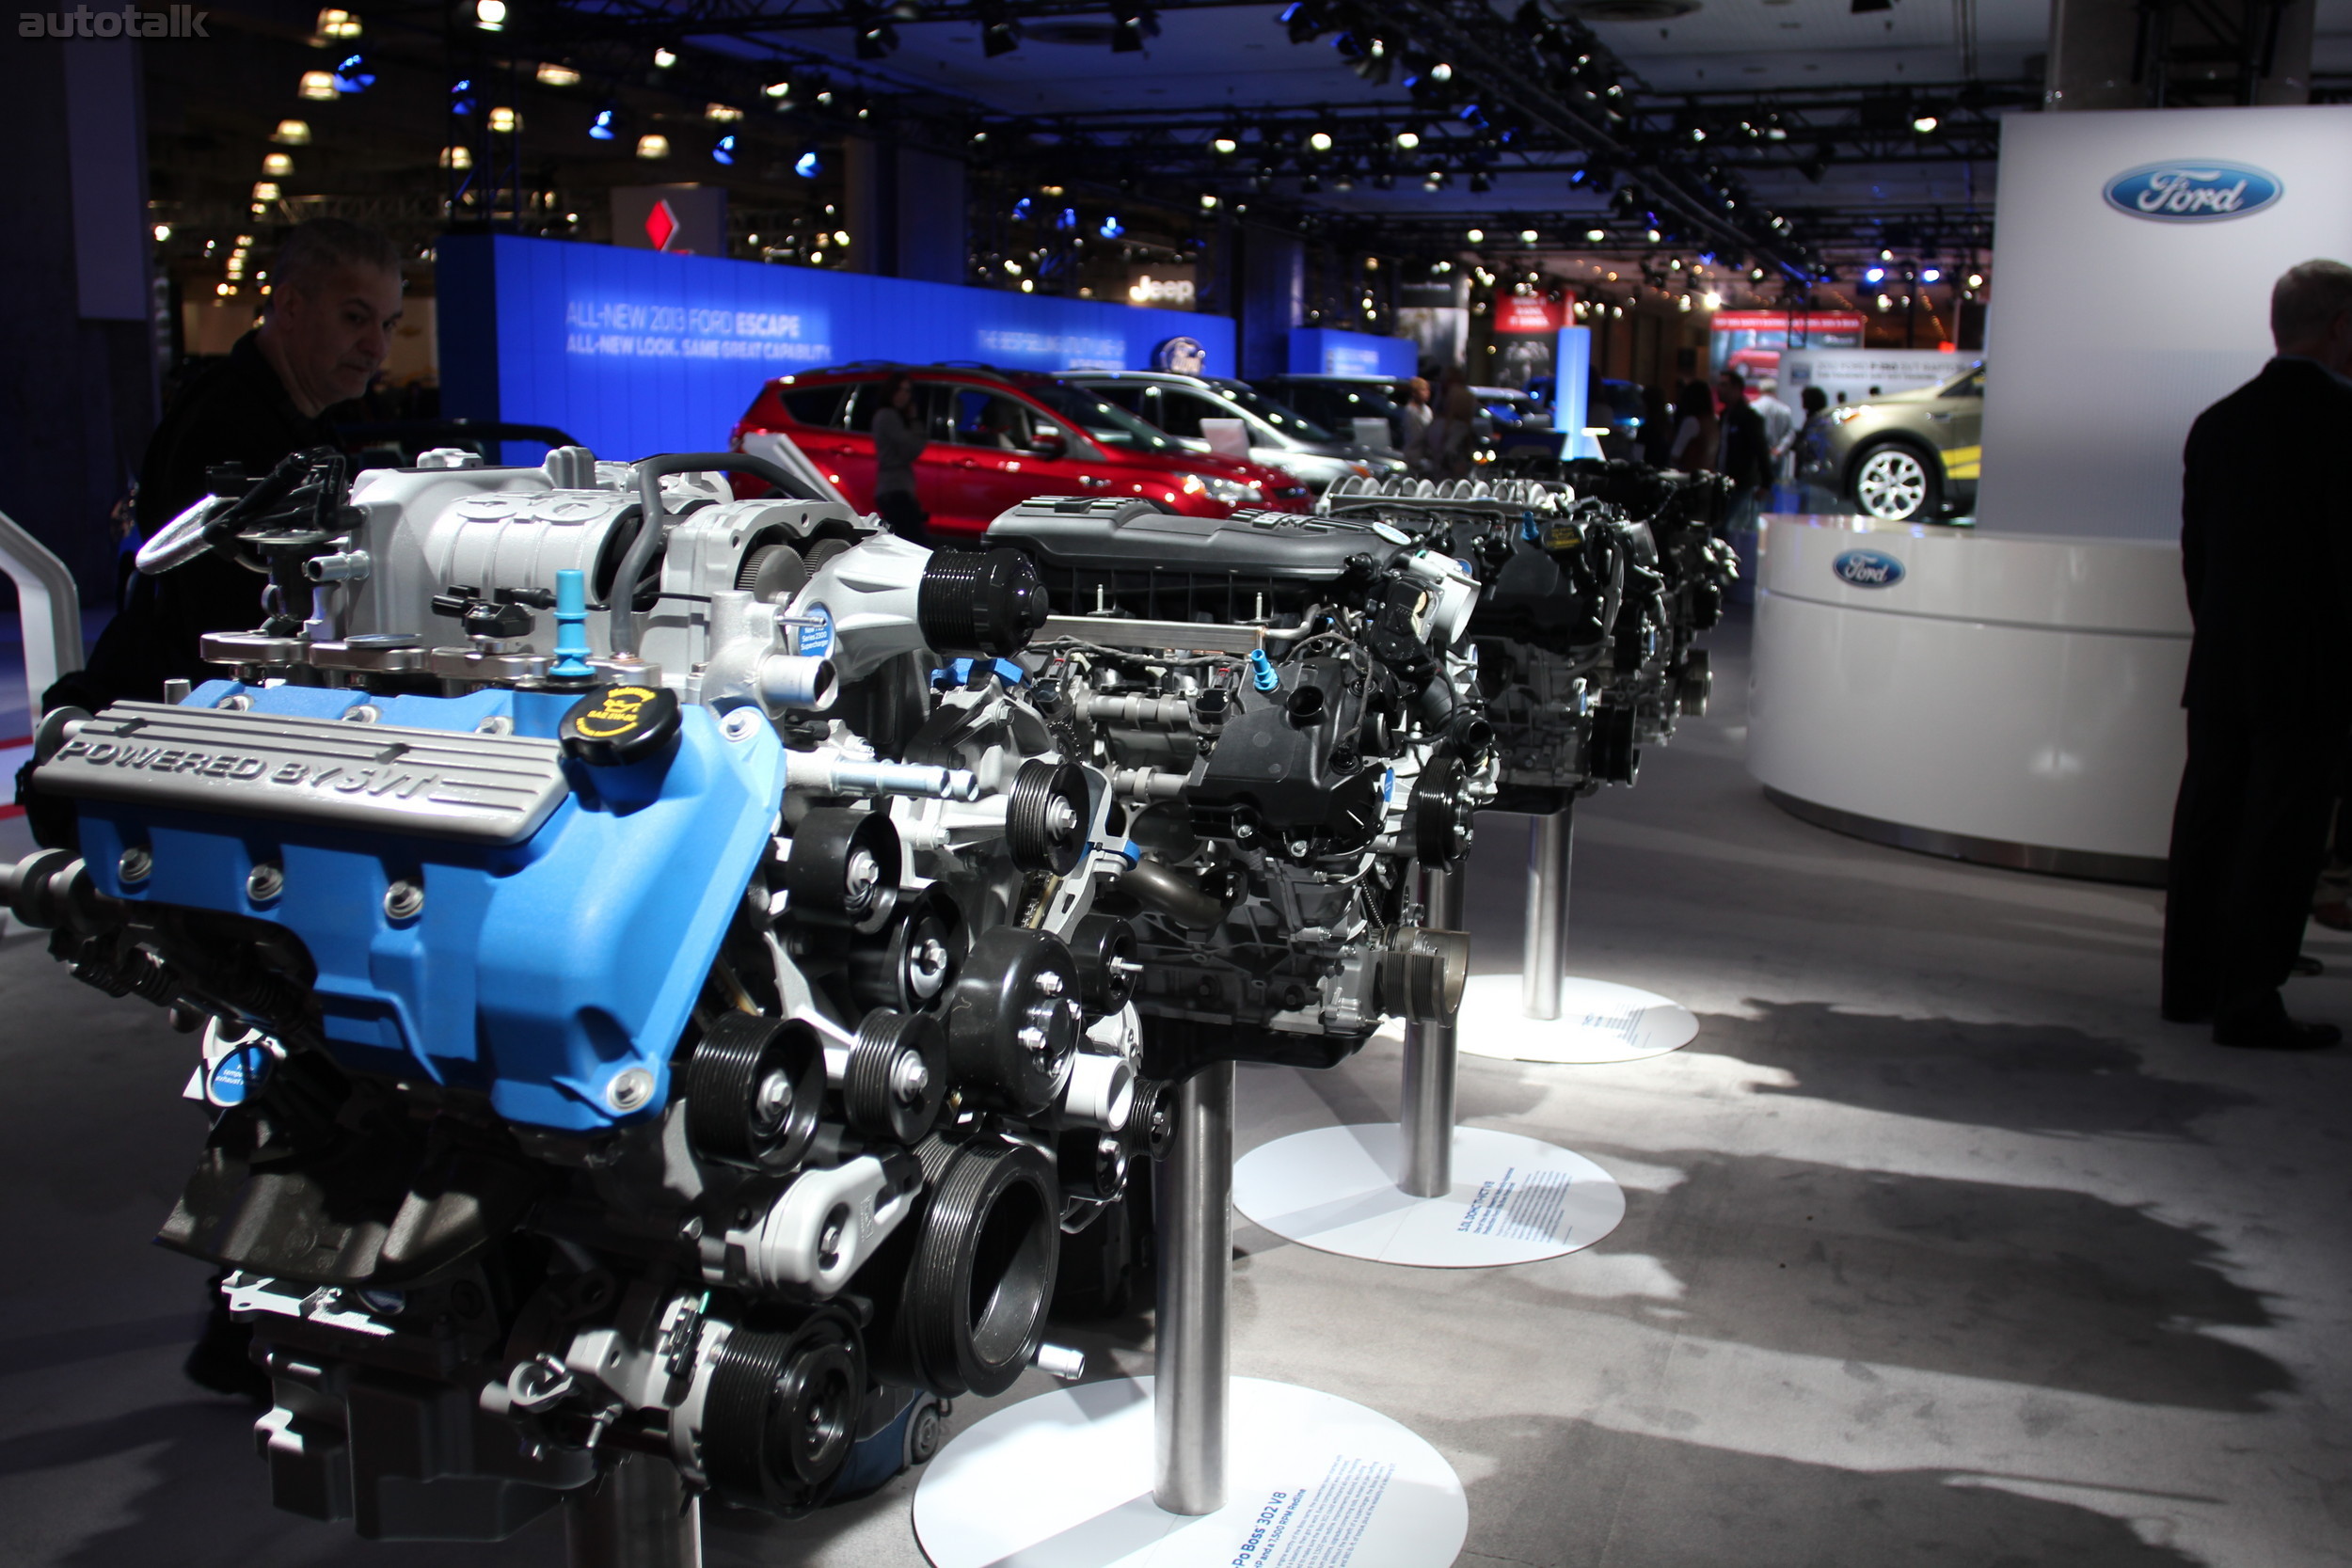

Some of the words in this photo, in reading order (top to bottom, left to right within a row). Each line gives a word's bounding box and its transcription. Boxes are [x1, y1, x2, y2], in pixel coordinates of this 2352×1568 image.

[2137, 169, 2250, 213] Ford
[1129, 276, 1195, 303] Jeep
[565, 301, 649, 331] ALL-NEW
[650, 305, 685, 333] 2013
[689, 308, 734, 335] FORD
[736, 311, 800, 338] ESCAPE
[566, 334, 634, 355] ALL-NEW
[682, 339, 719, 357] SAME
[722, 341, 761, 359] GREAT
[1845, 553, 1890, 582] Ford
[801, 640, 829, 650] Supercharger
[56, 741, 268, 781] POWERED
[271, 762, 343, 787] BY
[335, 768, 439, 799] SVT
[1257, 1506, 1278, 1525] 302
[1268, 1492, 1286, 1504] V8
[1260, 1547, 1272, 1560] and
[1268, 1526, 1285, 1543] 7,500
[1279, 1511, 1293, 1525] RPM
[1287, 1489, 1306, 1510] Redline
